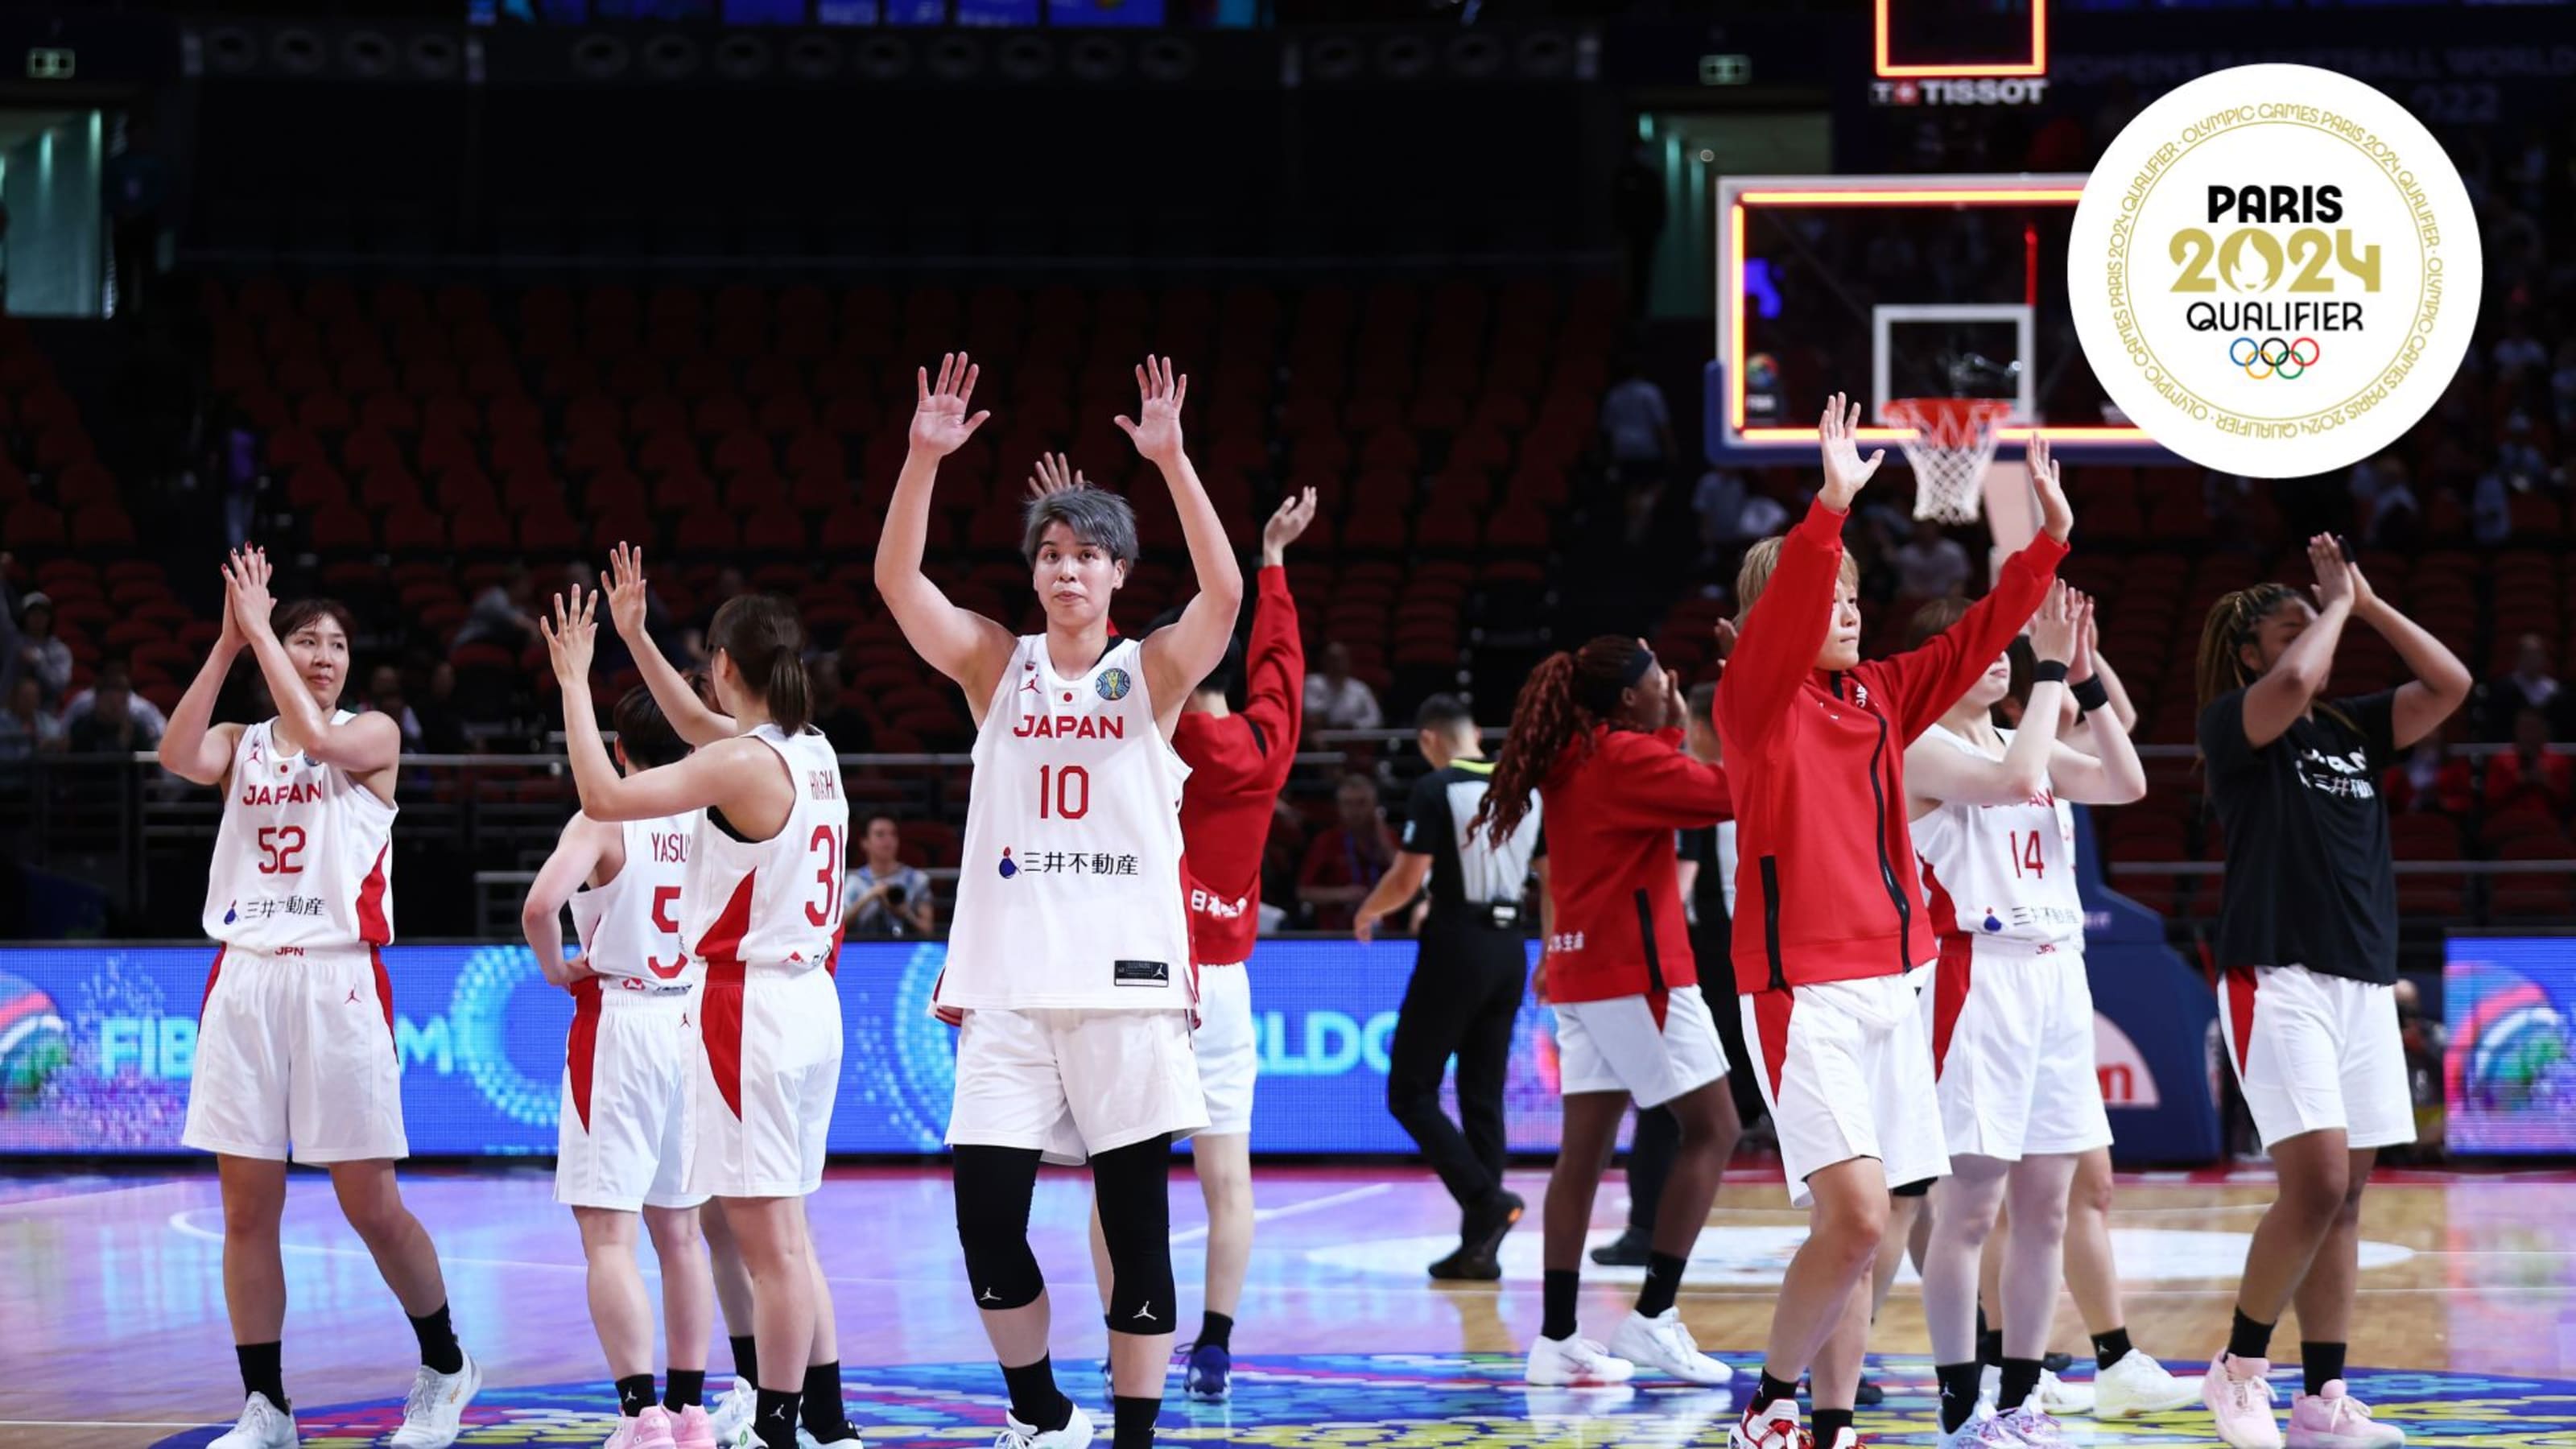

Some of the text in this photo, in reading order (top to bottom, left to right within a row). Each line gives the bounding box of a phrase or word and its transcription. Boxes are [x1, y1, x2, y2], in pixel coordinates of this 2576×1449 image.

[1921, 79, 2049, 105] TISSOT
[1013, 714, 1124, 739] JAPAN
[243, 780, 323, 806] JAPAN
[1040, 764, 1089, 820] 10
[258, 825, 306, 874] 52
[651, 832, 691, 863] YASU
[2010, 830, 2044, 879] 14
[805, 824, 843, 927] 31
[1024, 851, 1138, 876] 三井不動産
[648, 886, 688, 979] 5
[275, 946, 304, 957] JPN
